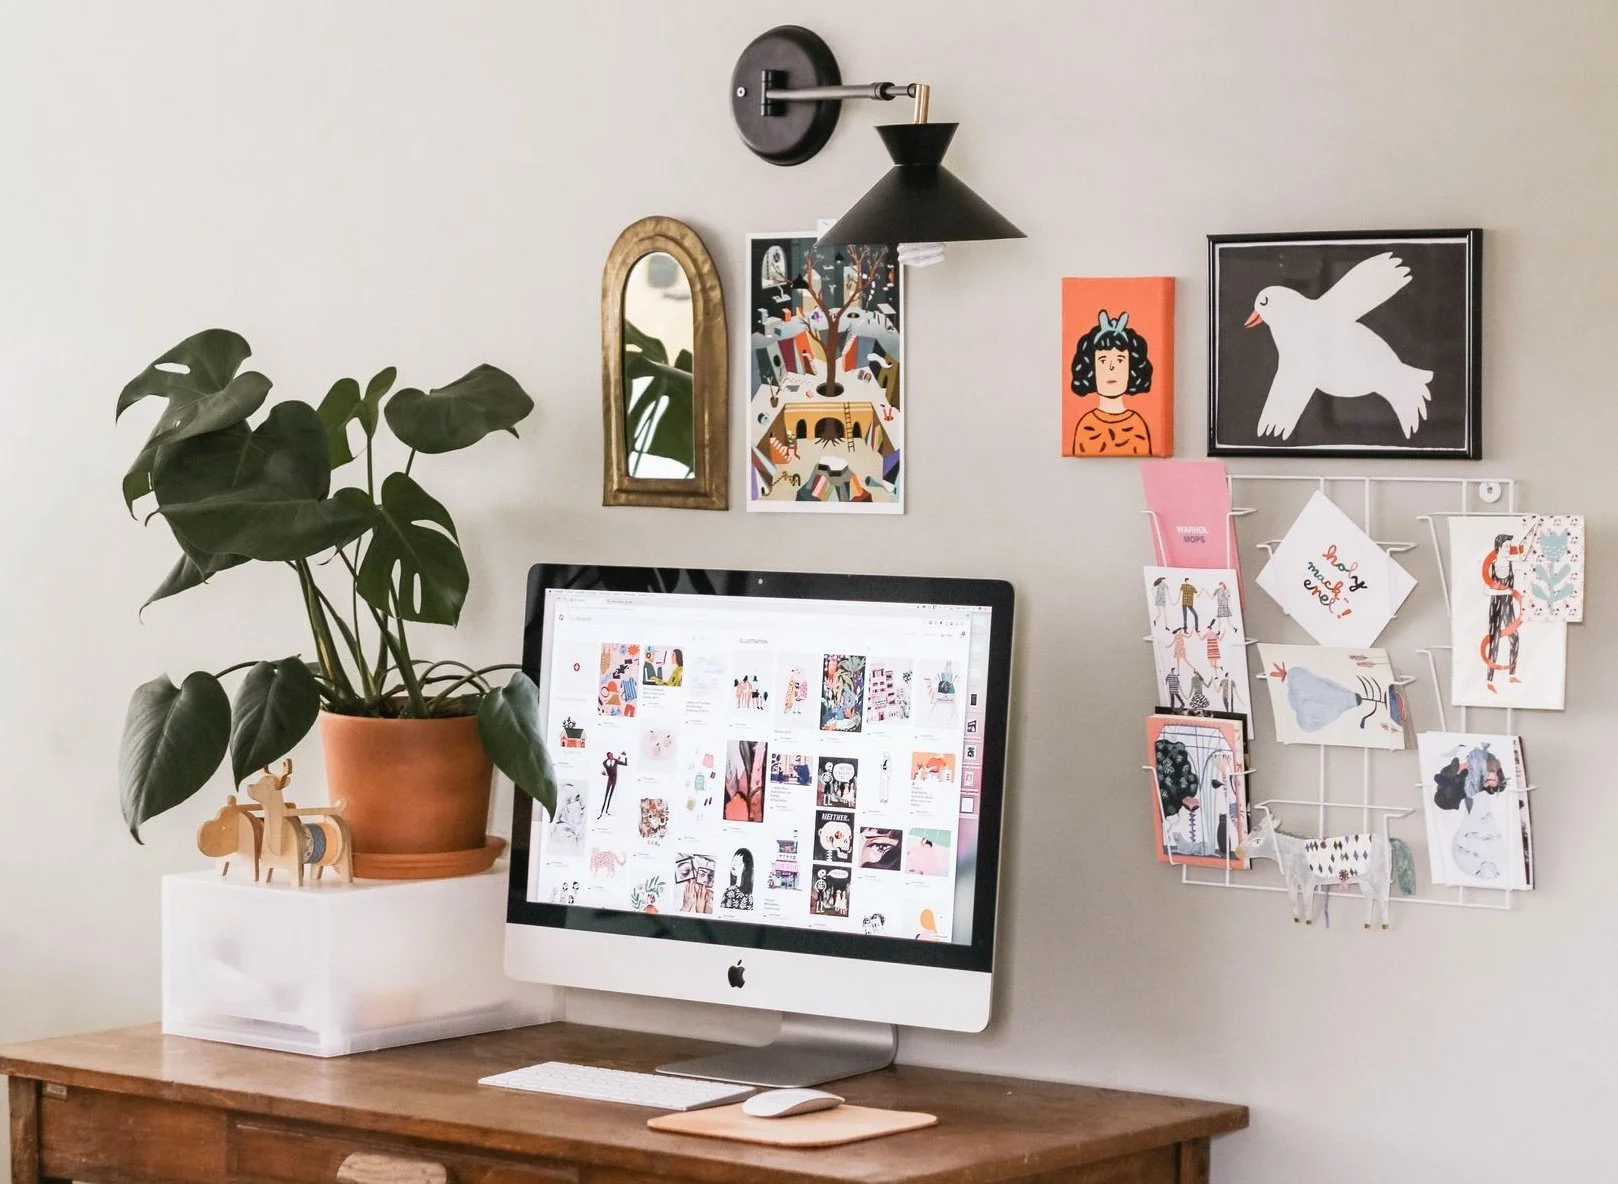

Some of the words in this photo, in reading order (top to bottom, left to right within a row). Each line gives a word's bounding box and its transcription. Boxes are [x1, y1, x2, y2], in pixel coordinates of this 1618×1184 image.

[1176, 526, 1208, 535] WARHOL
[1183, 535, 1206, 543] MOPS
[1322, 544, 1368, 592] holy
